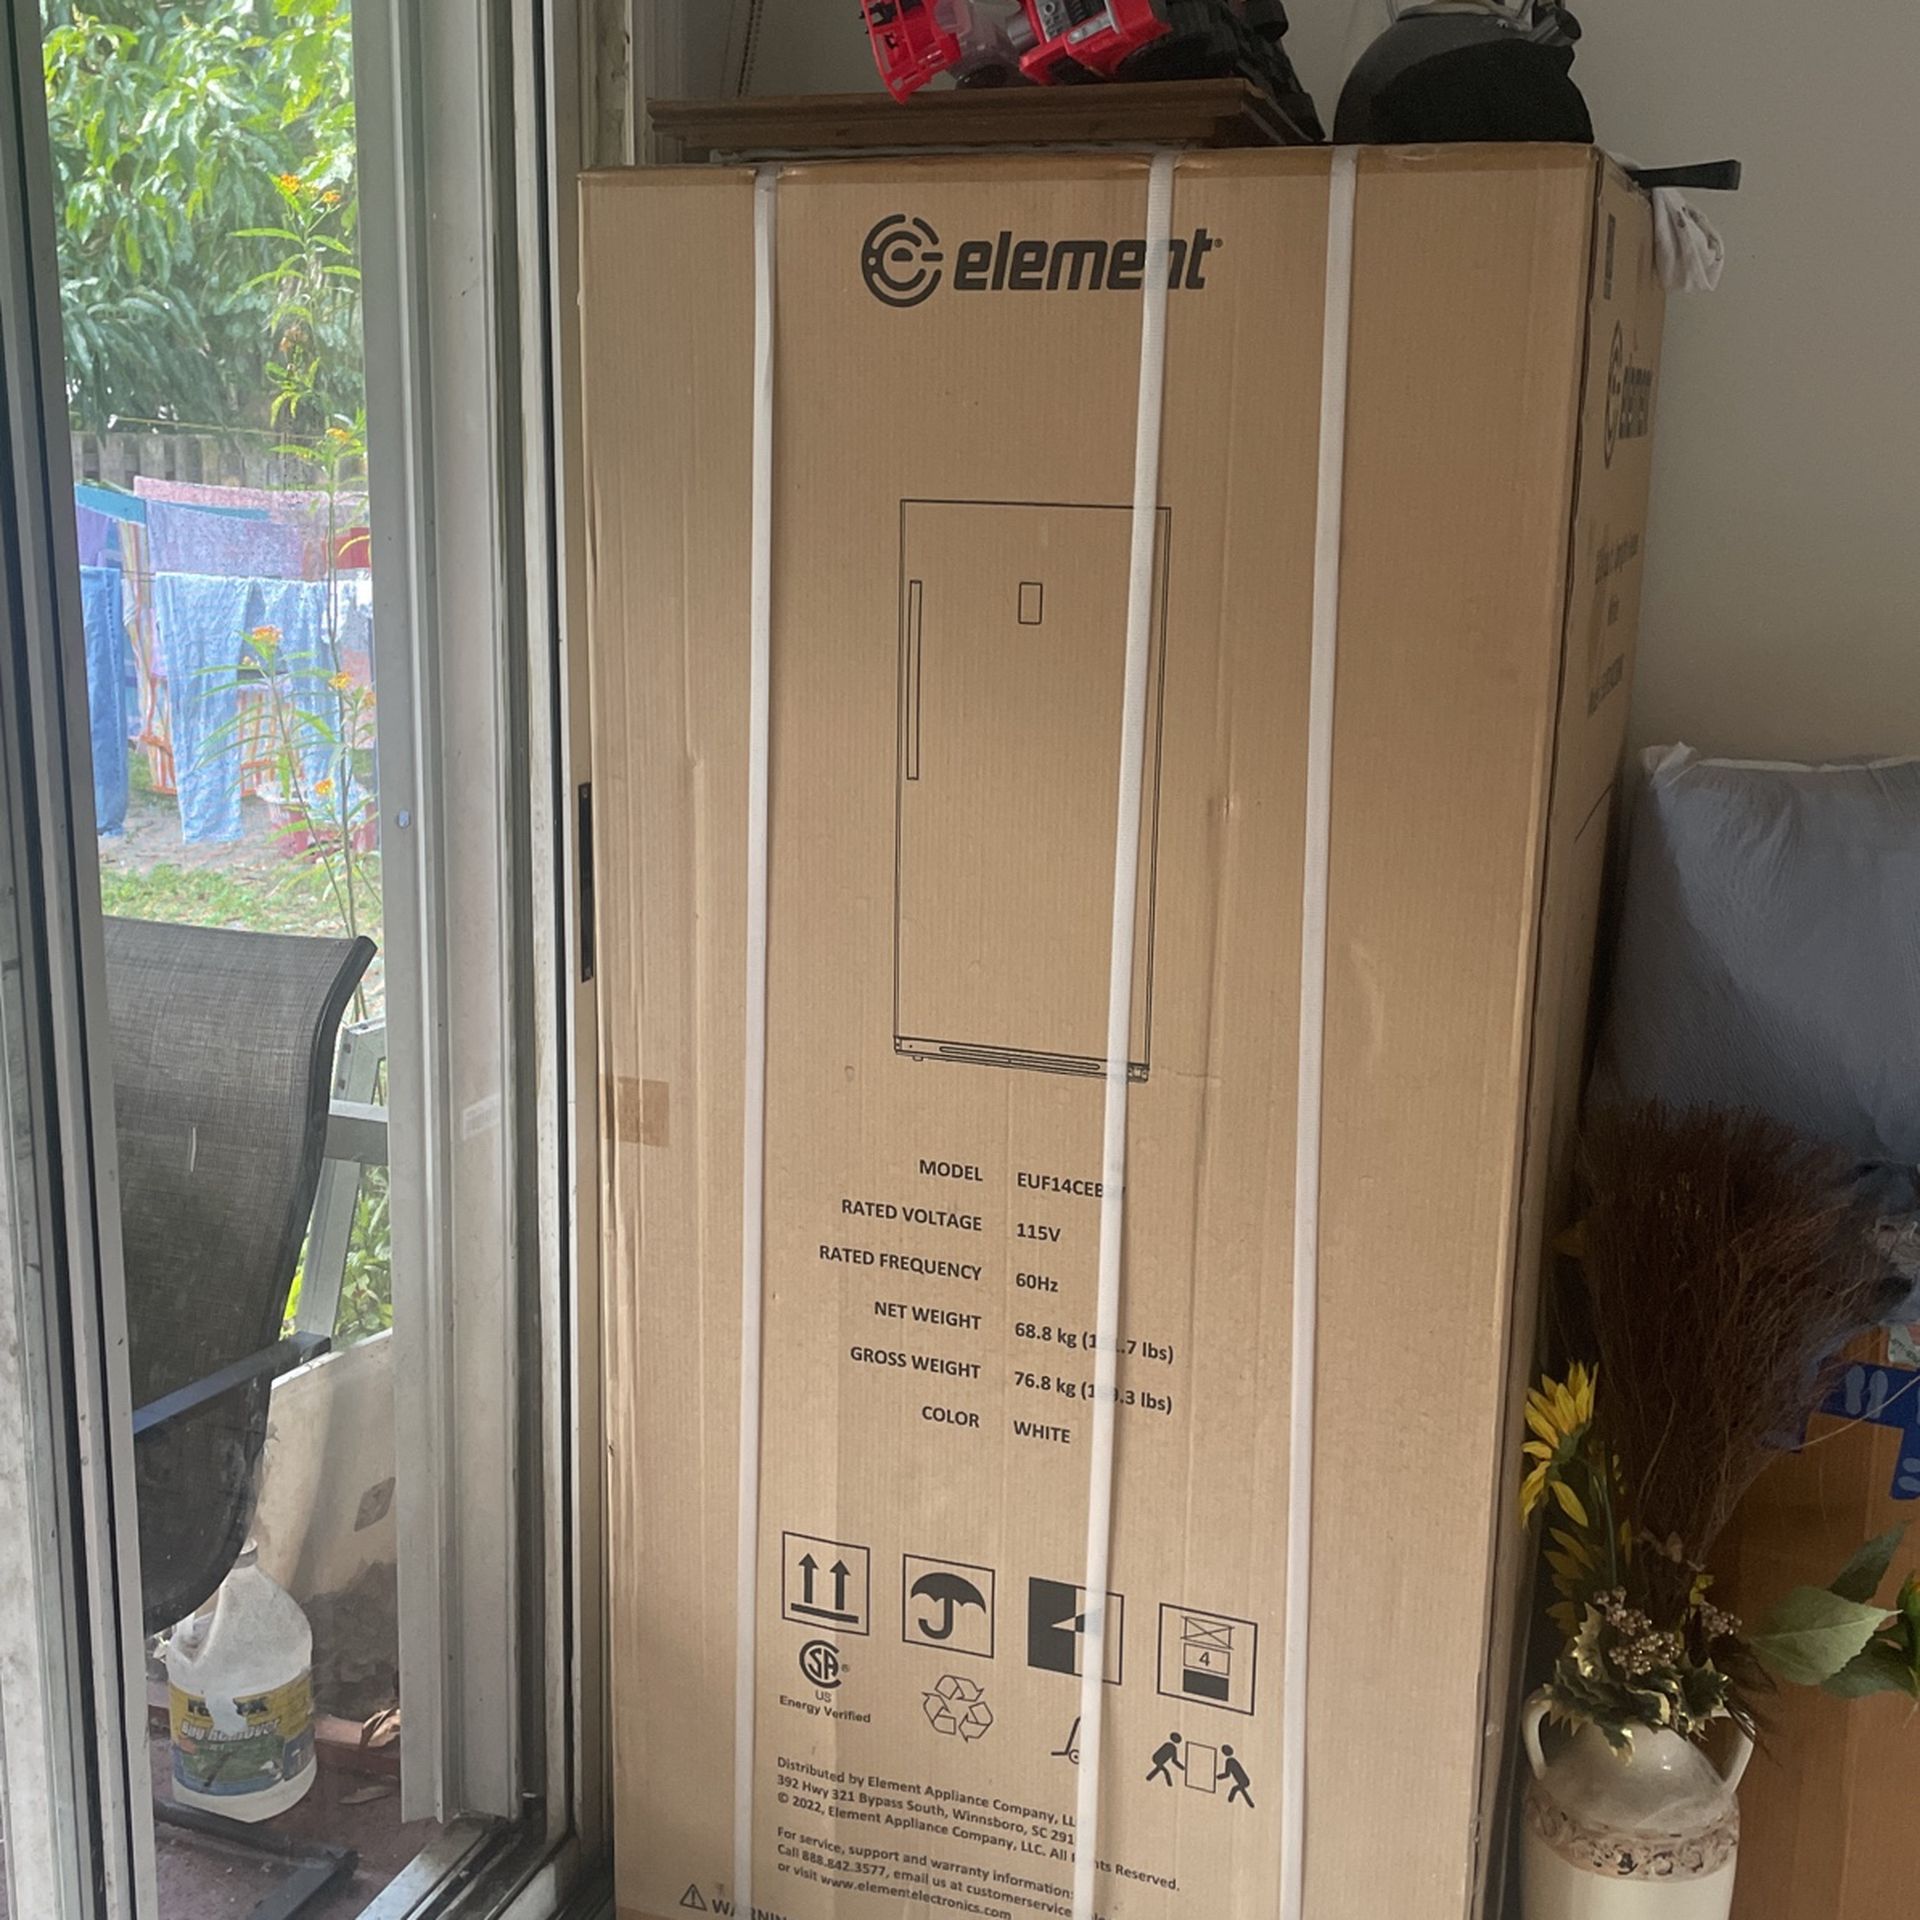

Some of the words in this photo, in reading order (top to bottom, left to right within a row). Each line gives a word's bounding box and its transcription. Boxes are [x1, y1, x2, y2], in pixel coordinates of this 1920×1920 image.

[953, 228, 1212, 291] element
[919, 1159, 984, 1182] MODEL
[1017, 1172, 1125, 1198] EUF14CEB
[842, 1199, 898, 1220] RATED
[902, 1207, 983, 1232] VOLTAGE
[1017, 1223, 1061, 1242] 115V
[819, 1245, 875, 1266] RATED
[880, 1253, 983, 1281] FREQUENCY
[1016, 1273, 1059, 1293] 60Hz
[874, 1301, 908, 1319] NET
[911, 1306, 982, 1330] WEIGHT
[1015, 1322, 1052, 1341] 68.8
[1057, 1328, 1077, 1348] kg
[1082, 1331, 1137, 1354] (1.7
[1142, 1341, 1174, 1364] lbs)
[850, 1346, 907, 1367] GROSS
[911, 1355, 981, 1379] WEIGHT
[1014, 1371, 1051, 1391] 76.8
[1056, 1377, 1076, 1398] kg
[1081, 1381, 1135, 1405] (1.3
[1141, 1391, 1173, 1415] lbs)
[922, 1406, 980, 1428] COLOR
[1013, 1420, 1071, 1443] WHITE
[1199, 1651, 1210, 1667] 4
[779, 1694, 820, 1715] Energy
[824, 1706, 871, 1723] Verified
[815, 1690, 832, 1703] US
[777, 1756, 845, 1783] Distributed
[849, 1773, 864, 1788] by
[868, 1776, 921, 1795] Element
[924, 1786, 989, 1808] Appliance
[993, 1799, 1058, 1825] Company,
[1062, 1814, 1076, 1828] LL
[777, 1774, 799, 1790] 392
[802, 1781, 829, 1800] Hwy
[832, 1789, 855, 1802] 321
[859, 1792, 903, 1809] Bypass
[906, 1800, 949, 1819] South,
[953, 1808, 1028, 1836] Winnsboro,
[1031, 1825, 1048, 1839] SC
[1051, 1829, 1075, 1846] 291
[777, 1826, 797, 1841] For
[799, 1833, 846, 1855] service,
[849, 1845, 900, 1862] support
[903, 1853, 928, 1867] and
[931, 1859, 990, 1882] warranty
[993, 1869, 1074, 1901] information:
[777, 1843, 799, 1859] Call
[802, 1850, 890, 1879] 888.842.3577,
[893, 1868, 929, 1886] email
[932, 1877, 947, 1888] us
[950, 1881, 963, 1892] at
[793, 1796, 826, 1816] 2022,
[828, 1806, 882, 1824] Element
[884, 1814, 949, 1835] Appliance
[952, 1826, 1018, 1852] Company,
[1021, 1841, 1047, 1857] LLC.
[1050, 1849, 1067, 1862] All
[1115, 1864, 1181, 1892] Reserved.
[778, 1863, 791, 1873] or
[793, 1867, 818, 1881] visit
[820, 1874, 1012, 1920] www.elementelectronics.com
